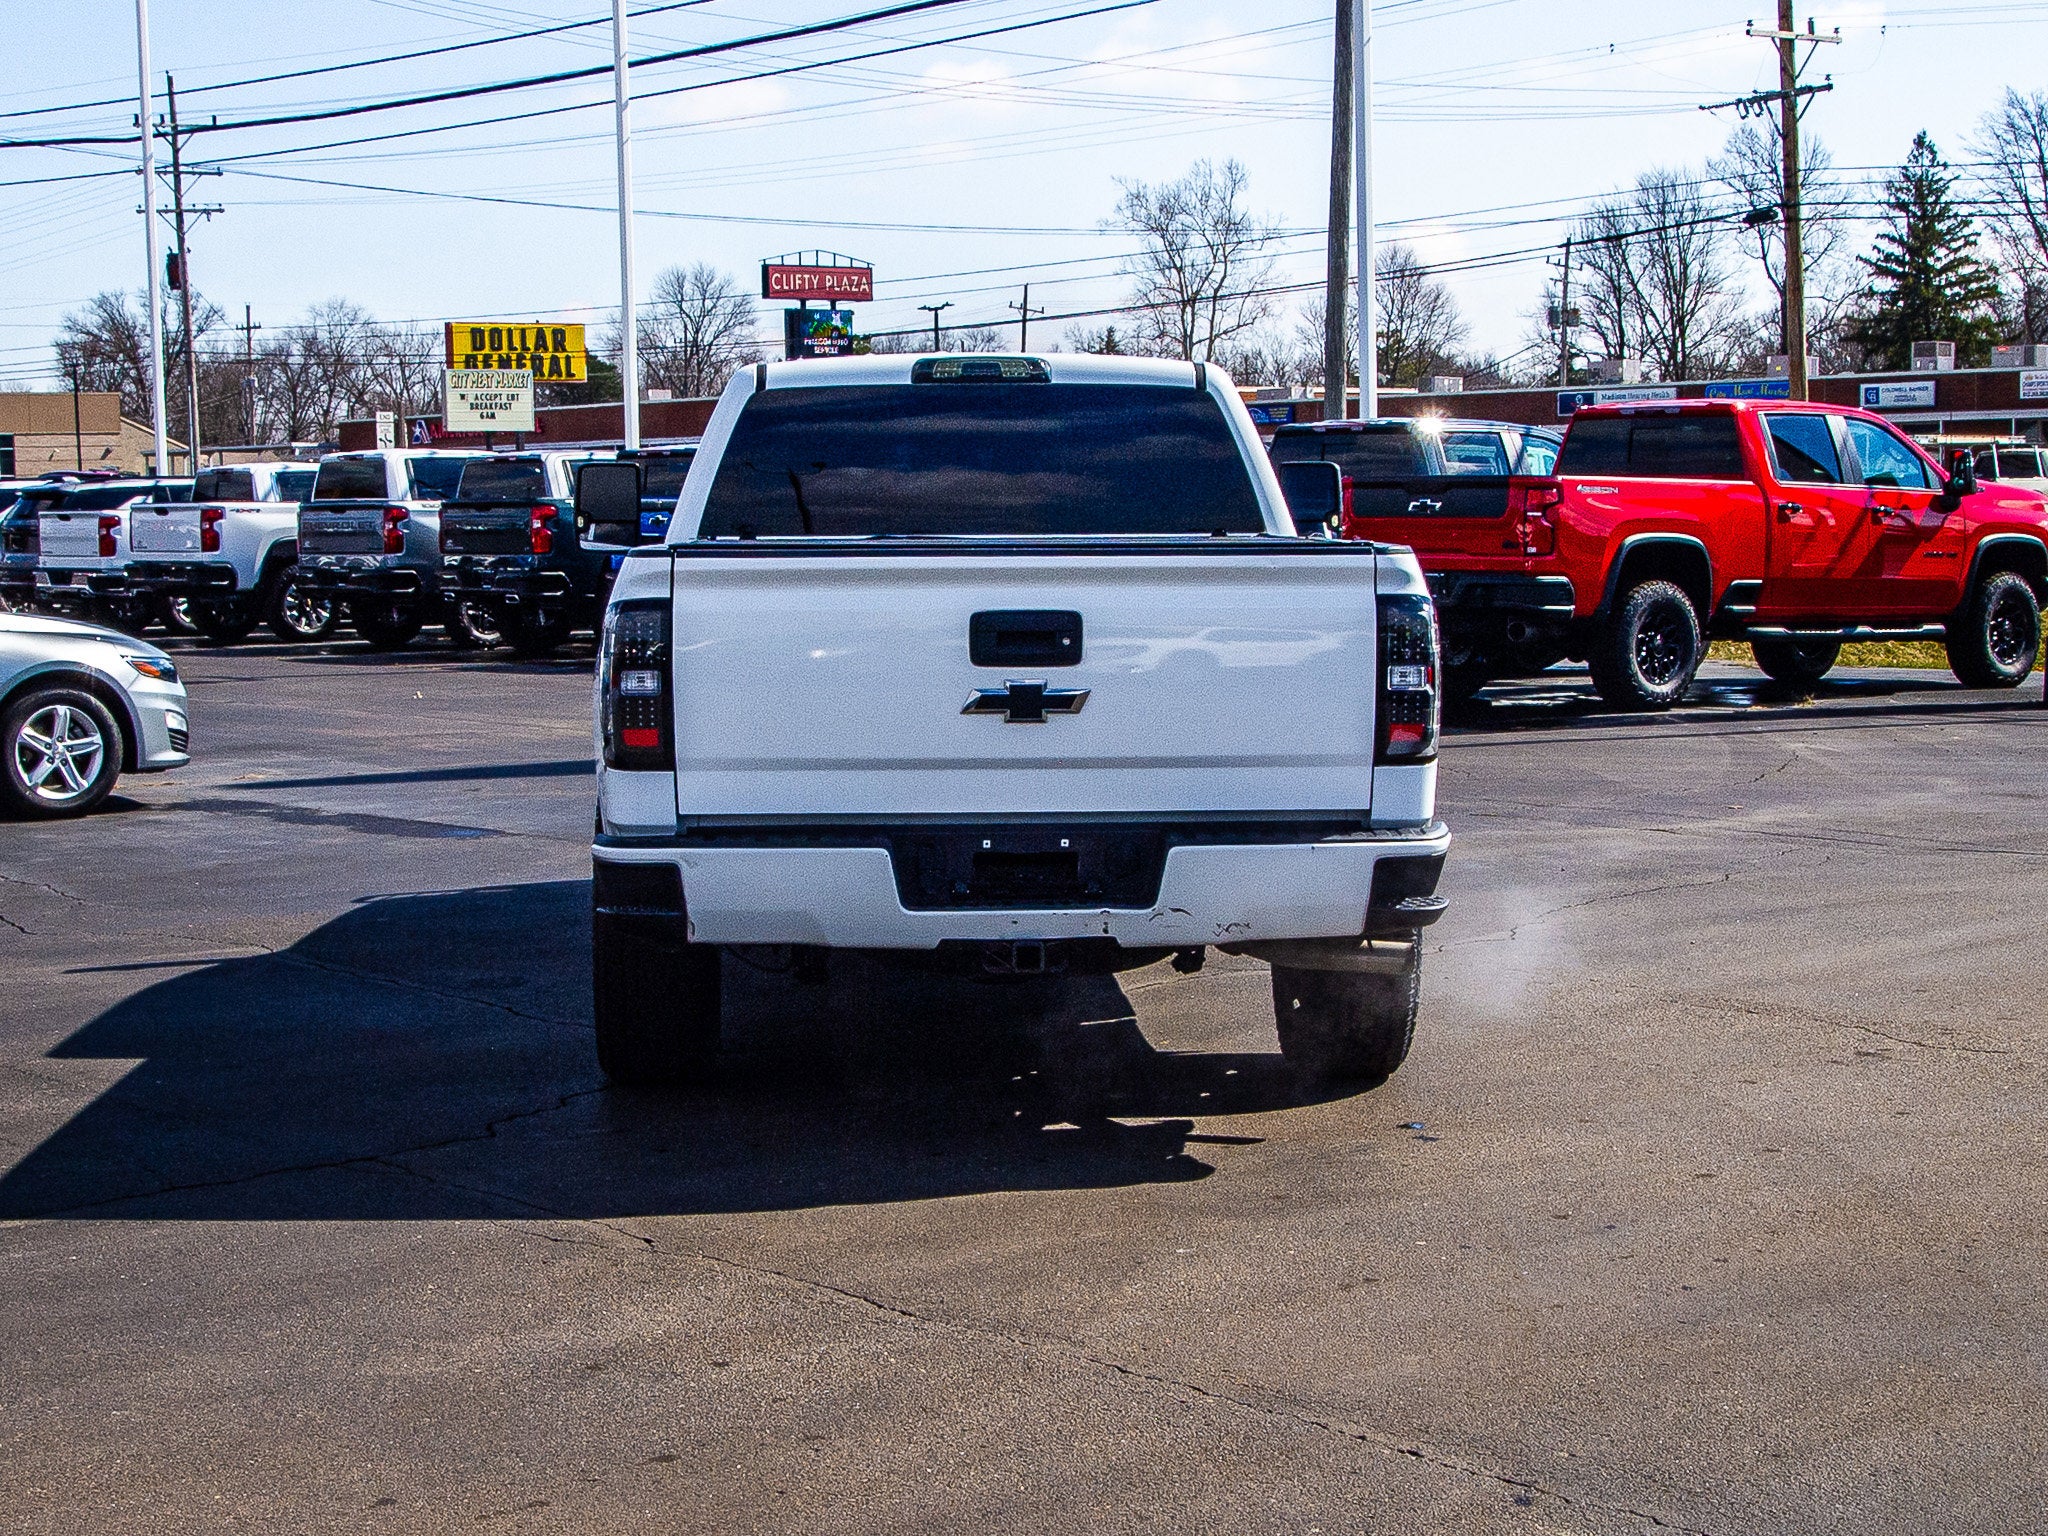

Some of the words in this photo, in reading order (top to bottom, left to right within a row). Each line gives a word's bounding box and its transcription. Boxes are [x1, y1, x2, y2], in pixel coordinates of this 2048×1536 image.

[771, 273, 819, 290] CLIFTY
[825, 275, 869, 292] PLAZA
[470, 327, 567, 352] DOLLAR
[451, 372, 469, 388] CITY
[470, 371, 494, 388] MEAT
[495, 371, 530, 388] MARKET
[469, 402, 512, 410] BREAKFAST
